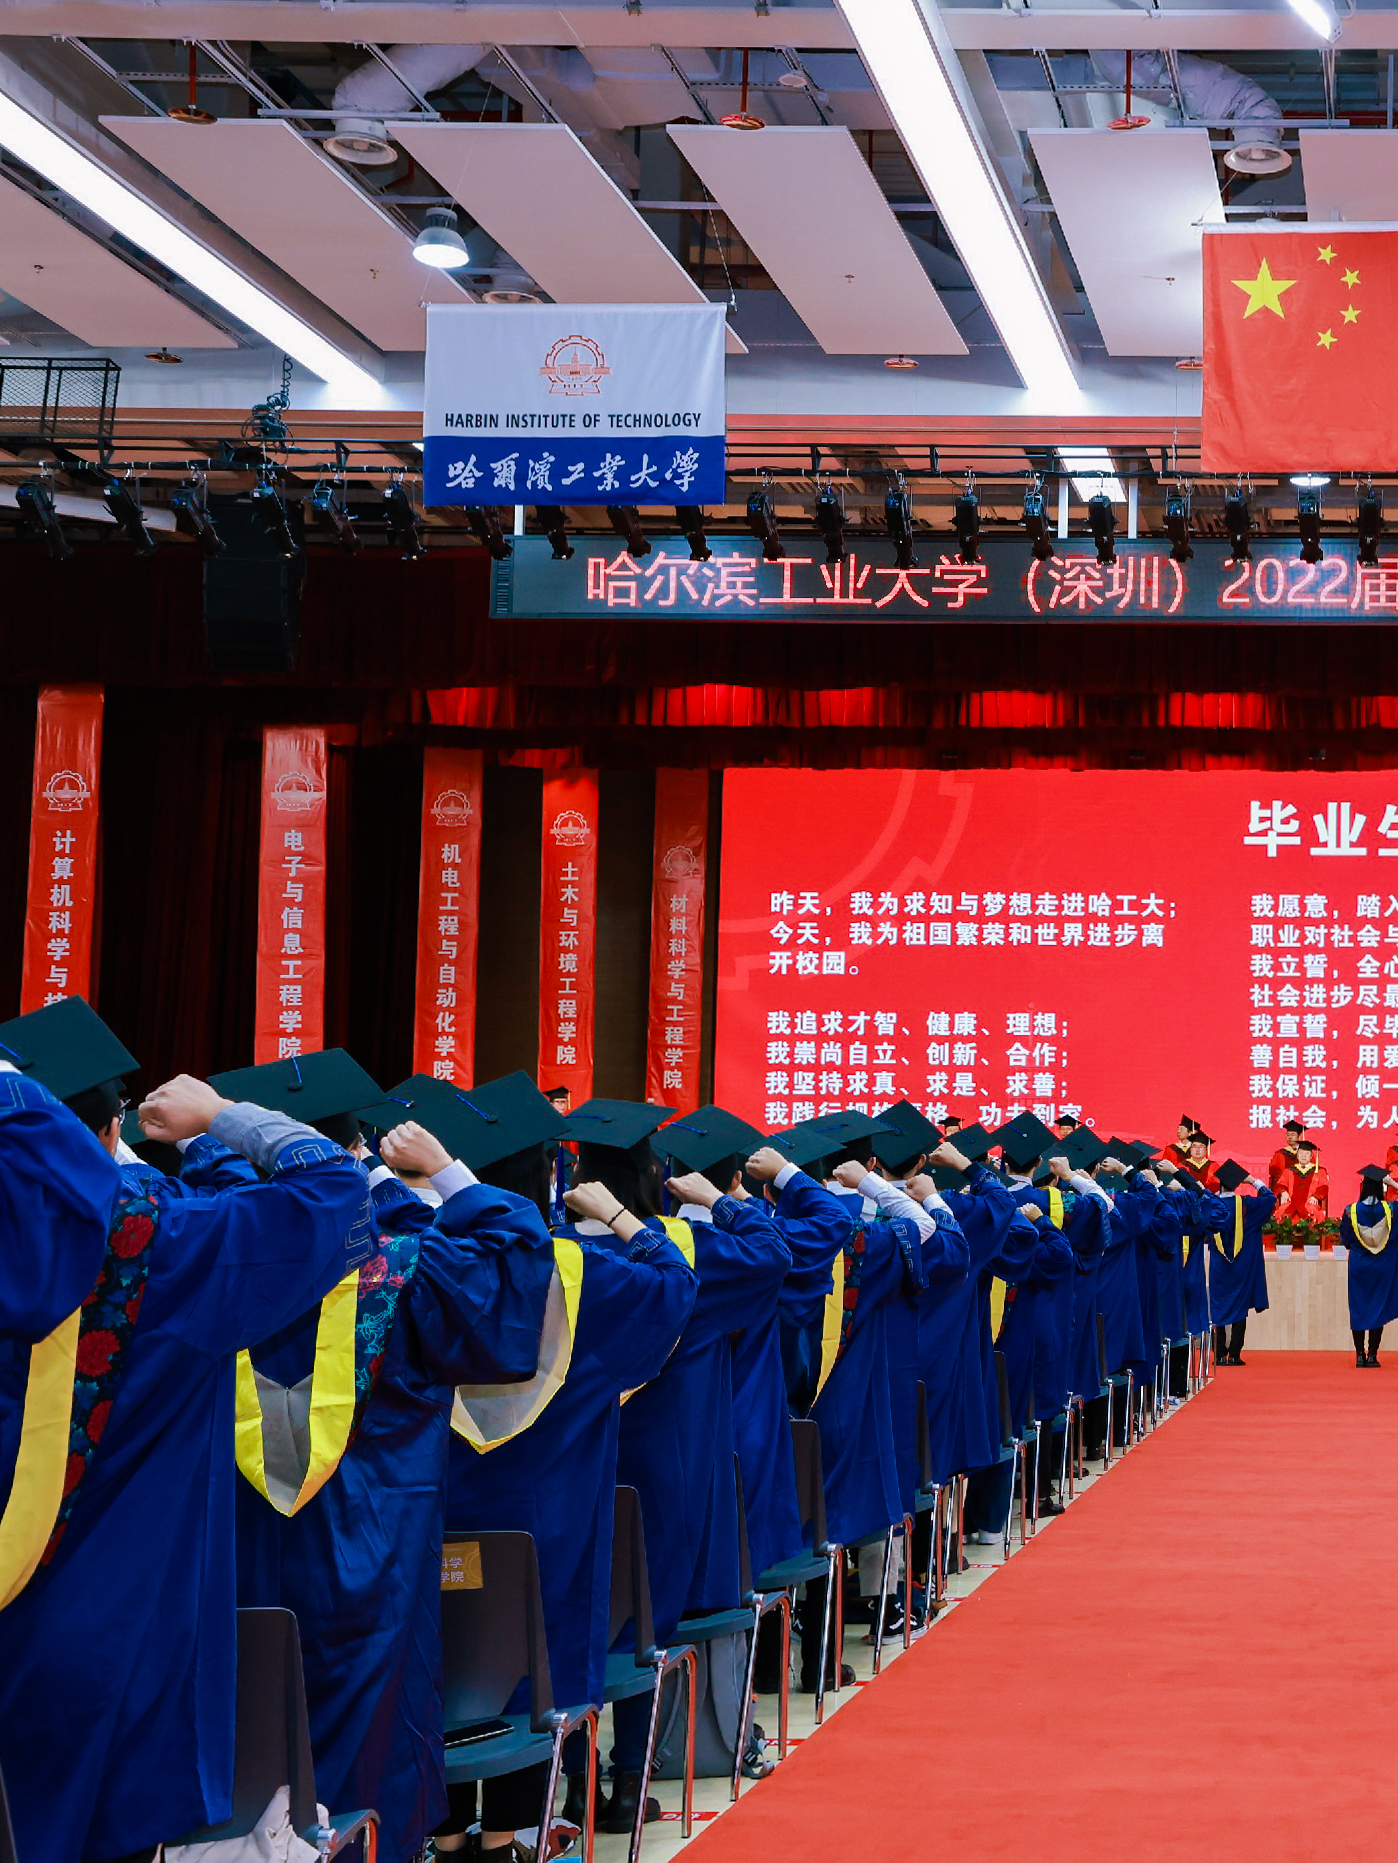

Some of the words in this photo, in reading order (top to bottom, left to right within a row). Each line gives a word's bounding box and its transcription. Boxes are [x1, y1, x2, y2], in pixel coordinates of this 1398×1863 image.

[445, 413, 499, 428] HARBIN
[505, 413, 576, 429] INSTITUTE
[582, 413, 601, 428] OF
[608, 412, 702, 428] TECHNOLOGY
[770, 890, 1177, 919] 昨天，我为求知与梦想走进哈工大；
[277, 829, 305, 1058] 电子与信息工程学院
[769, 920, 1165, 948] 今天，我为祖国繁荣和世界进步离
[433, 843, 462, 1081] 机电工程与自动化学院
[556, 862, 579, 1065] 土木与环境工程学院
[768, 950, 859, 976] 开校园。
[663, 894, 688, 1089] 材料科学与工程学院
[766, 1009, 1069, 1038] 我追求才智、健康、理想；
[765, 1040, 1068, 1068] 我崇尚自立、创新、合作；
[764, 1070, 1068, 1098] 我坚持求真、求是、求善；
